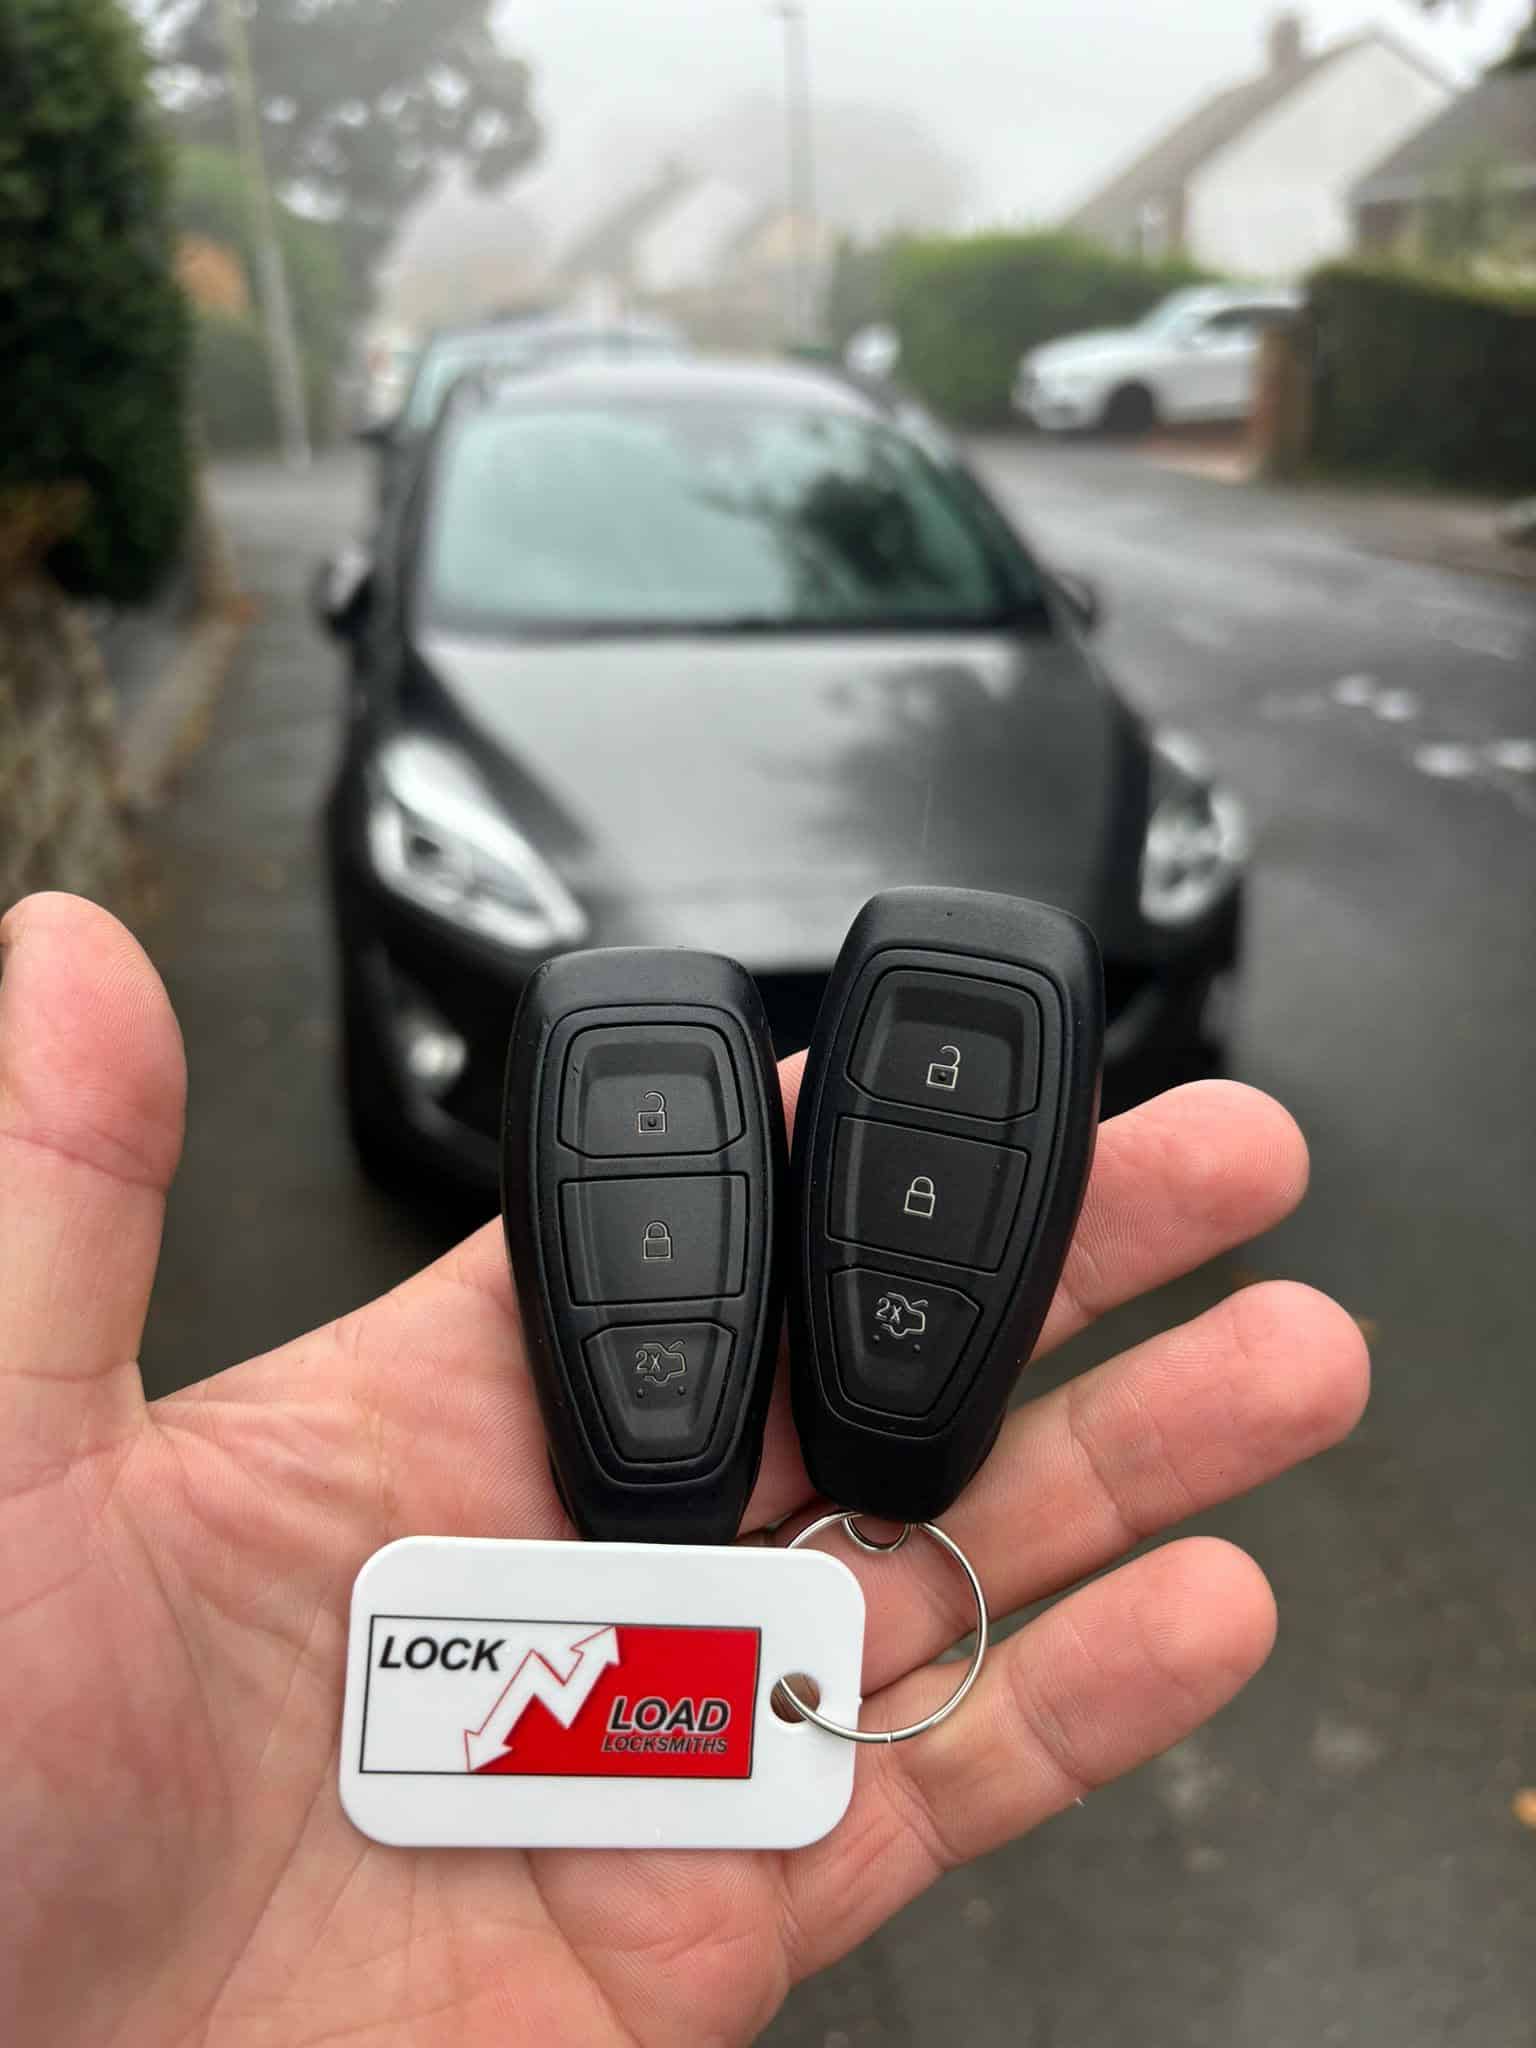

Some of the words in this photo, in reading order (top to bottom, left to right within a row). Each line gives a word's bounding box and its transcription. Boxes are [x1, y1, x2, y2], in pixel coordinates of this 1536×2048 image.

[379, 1635, 506, 1671] LOCK
[610, 1697, 730, 1732] LOAD
[601, 1736, 728, 1754] LOCKSMITHS
